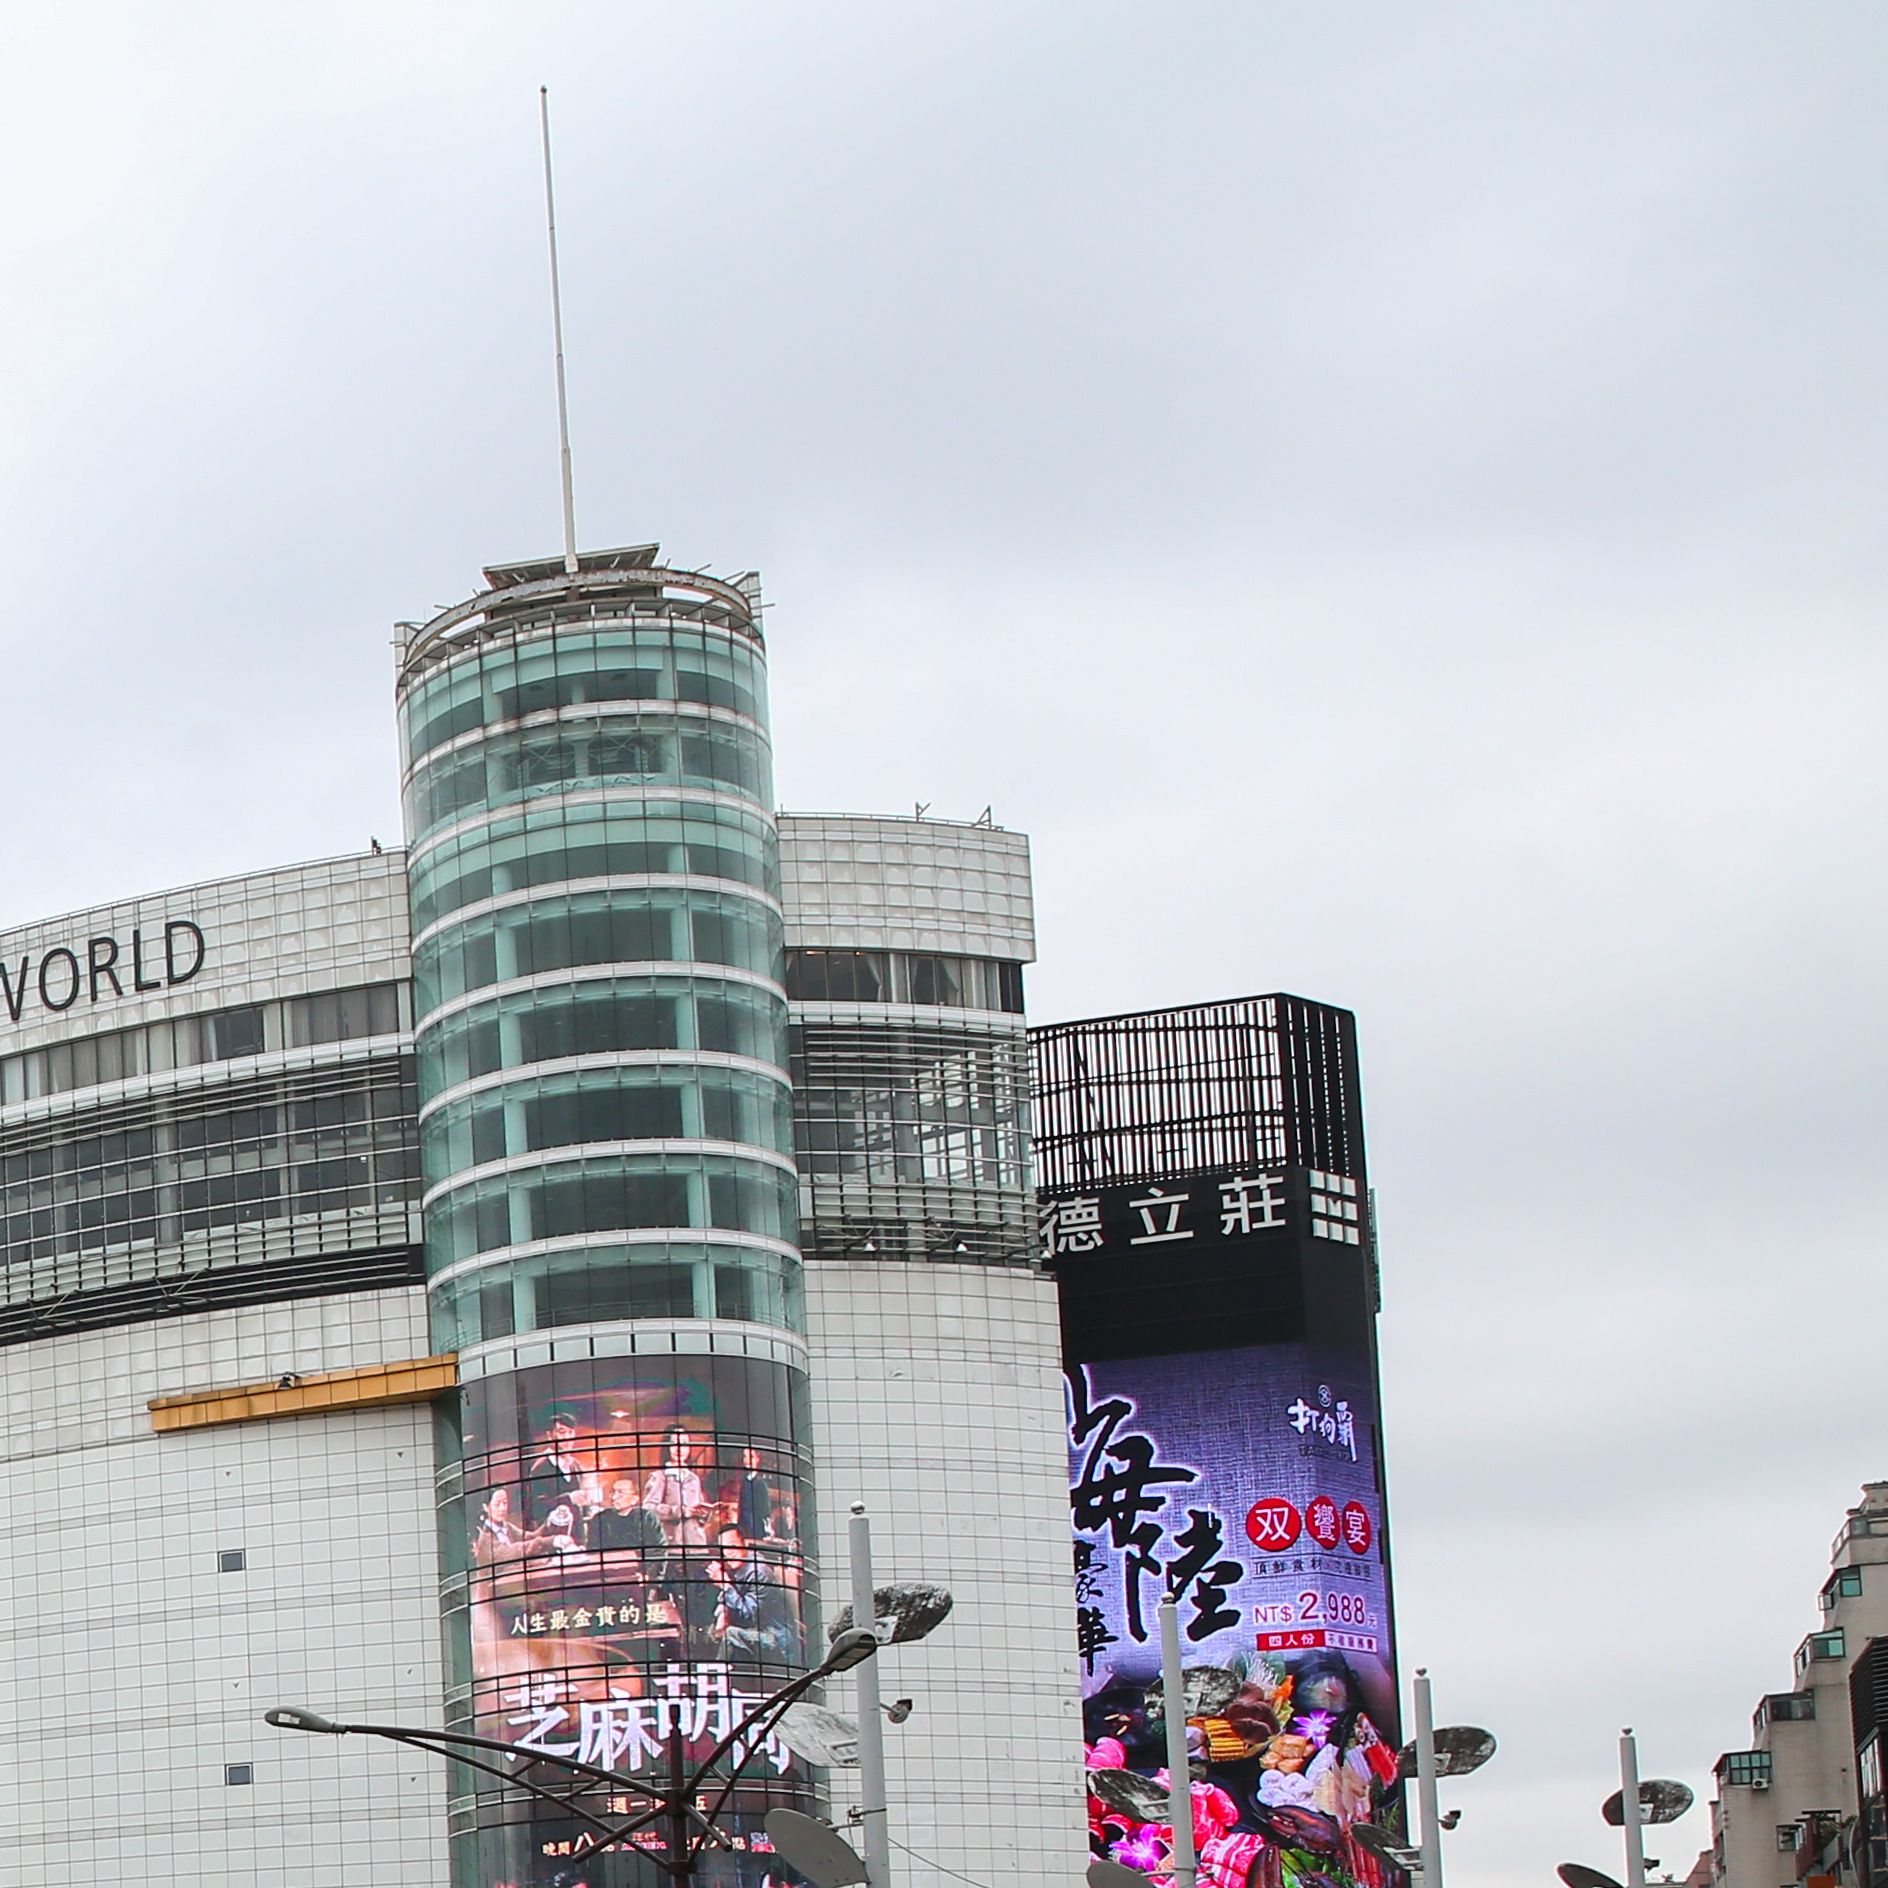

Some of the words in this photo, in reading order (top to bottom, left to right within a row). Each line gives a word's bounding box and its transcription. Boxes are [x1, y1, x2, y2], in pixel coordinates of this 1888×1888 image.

[1038, 1173, 1286, 1253] 德立莊
[1255, 1606, 1293, 1623] NT$
[1299, 1592, 1365, 1624] 2,988
[1268, 1634, 1315, 1647] 四人份
[504, 1662, 792, 1777] 芝麻胡同
